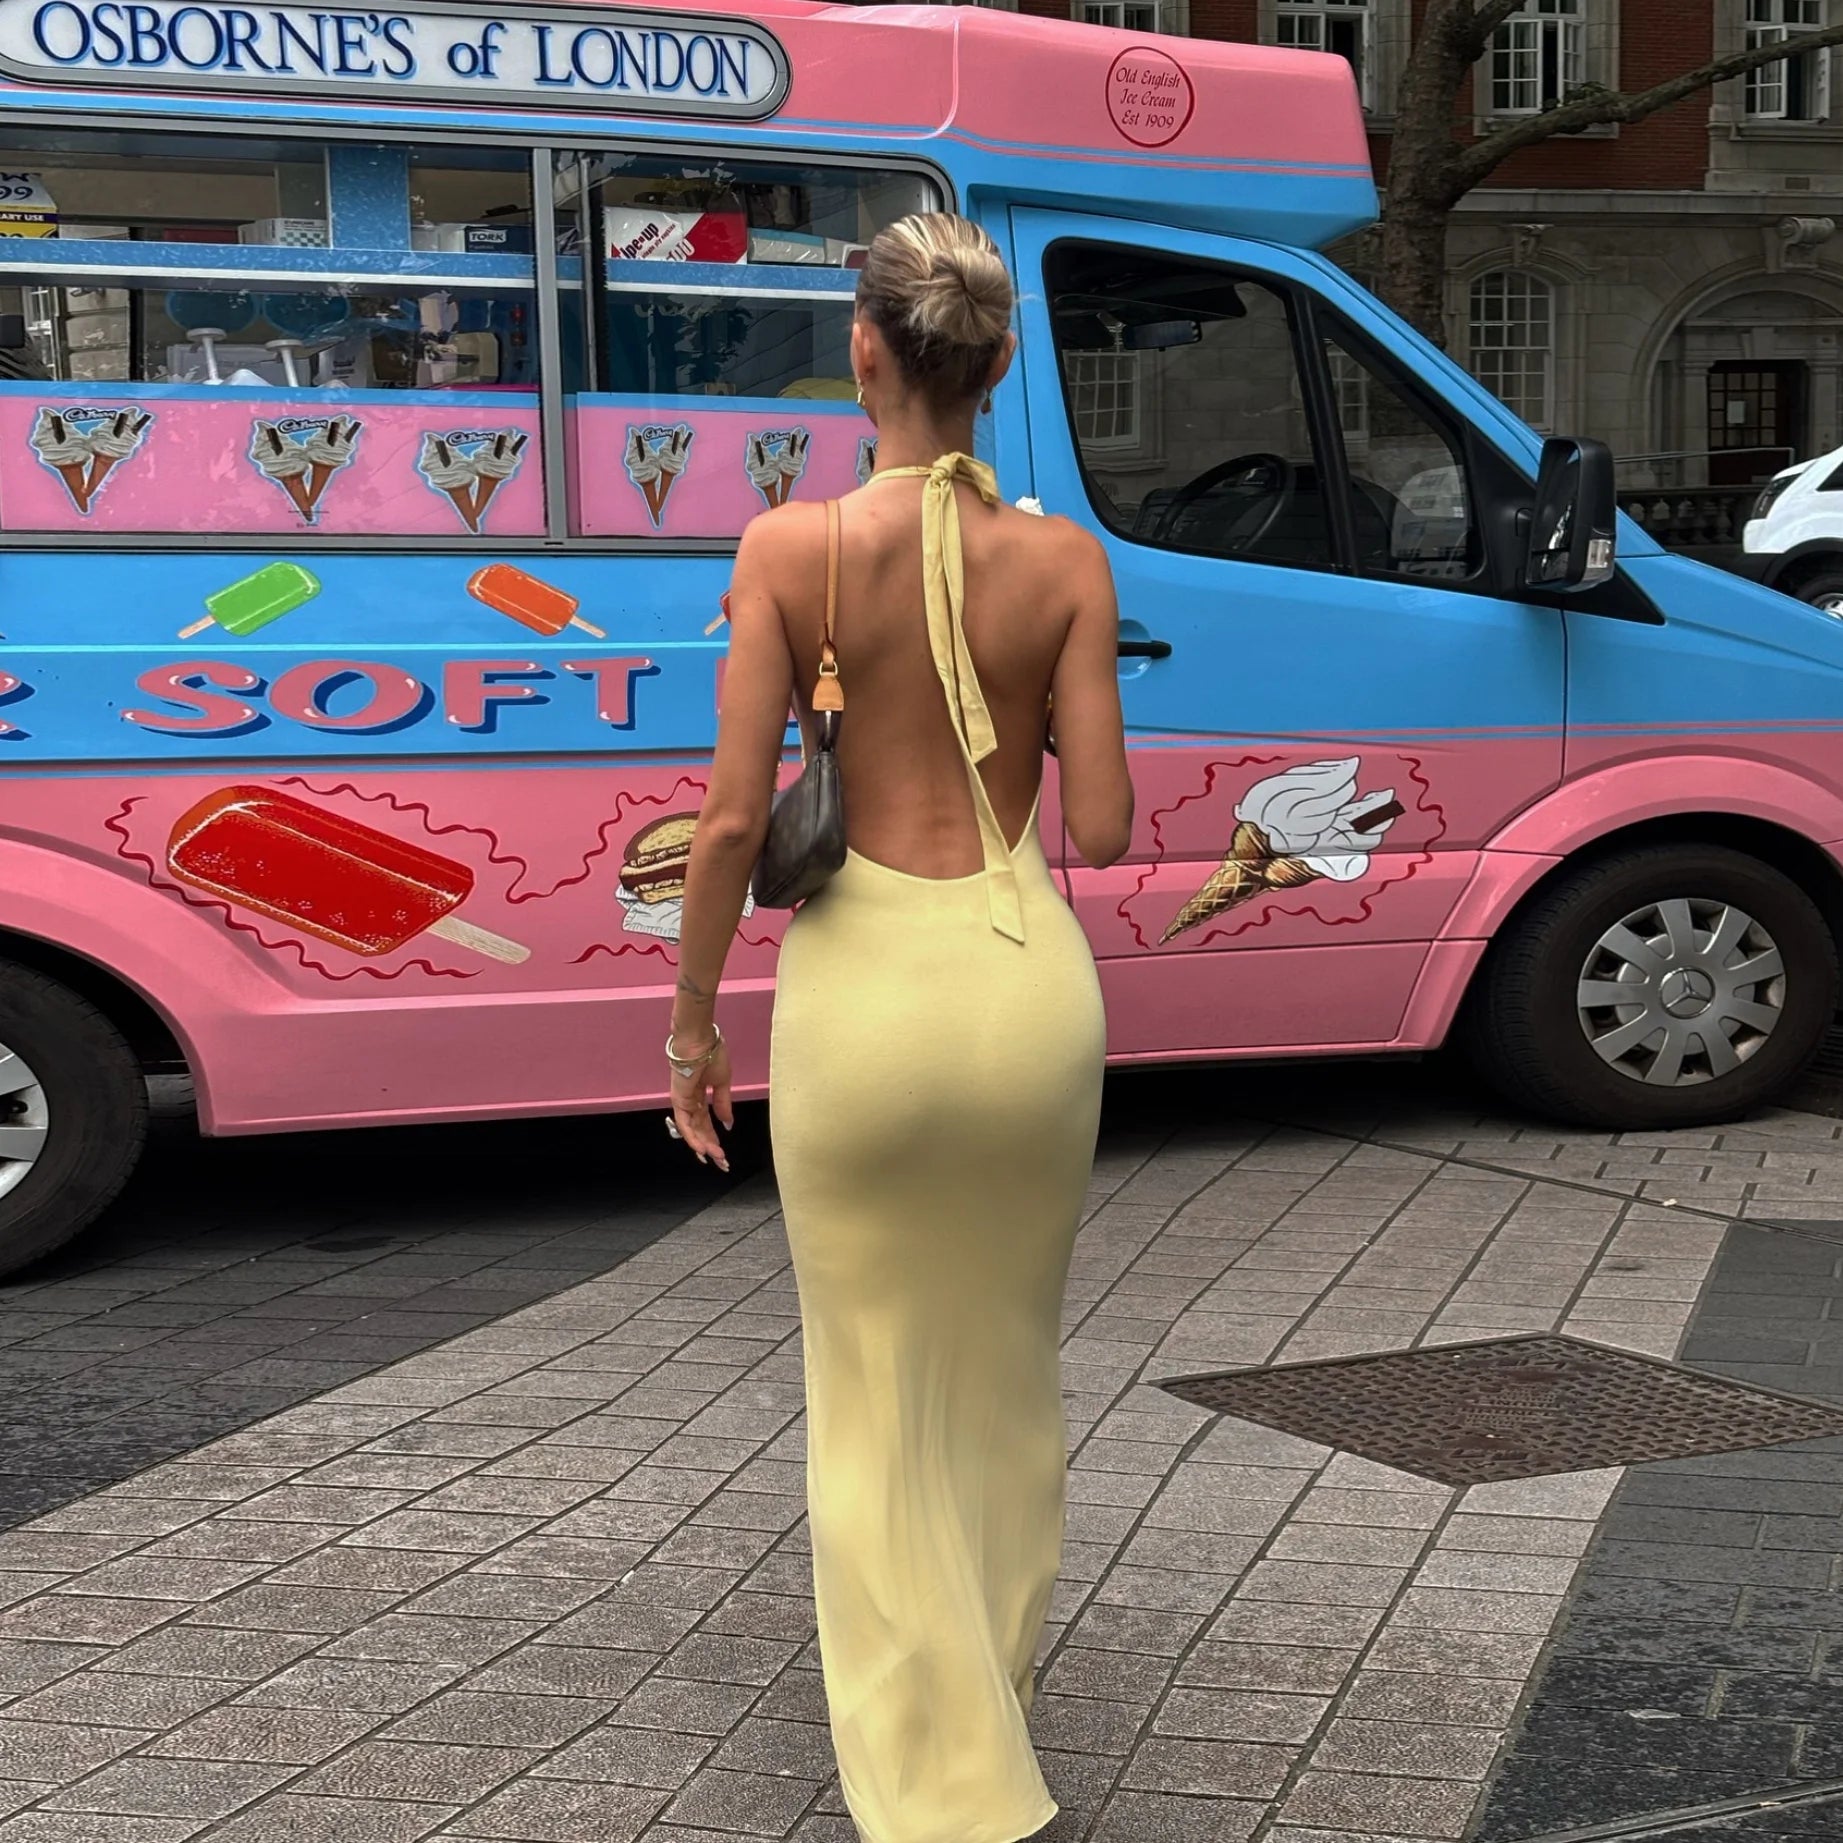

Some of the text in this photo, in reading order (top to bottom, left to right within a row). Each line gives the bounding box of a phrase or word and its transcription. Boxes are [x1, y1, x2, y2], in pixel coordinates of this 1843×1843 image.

[32, 0, 750, 98] OSBORNE'S of LONDON
[1116, 67, 1181, 90] Old English
[1141, 91, 1176, 107] Cream
[1122, 110, 1175, 128] Est 1909
[471, 232, 504, 241] TORK
[120, 656, 661, 739] SOFT
